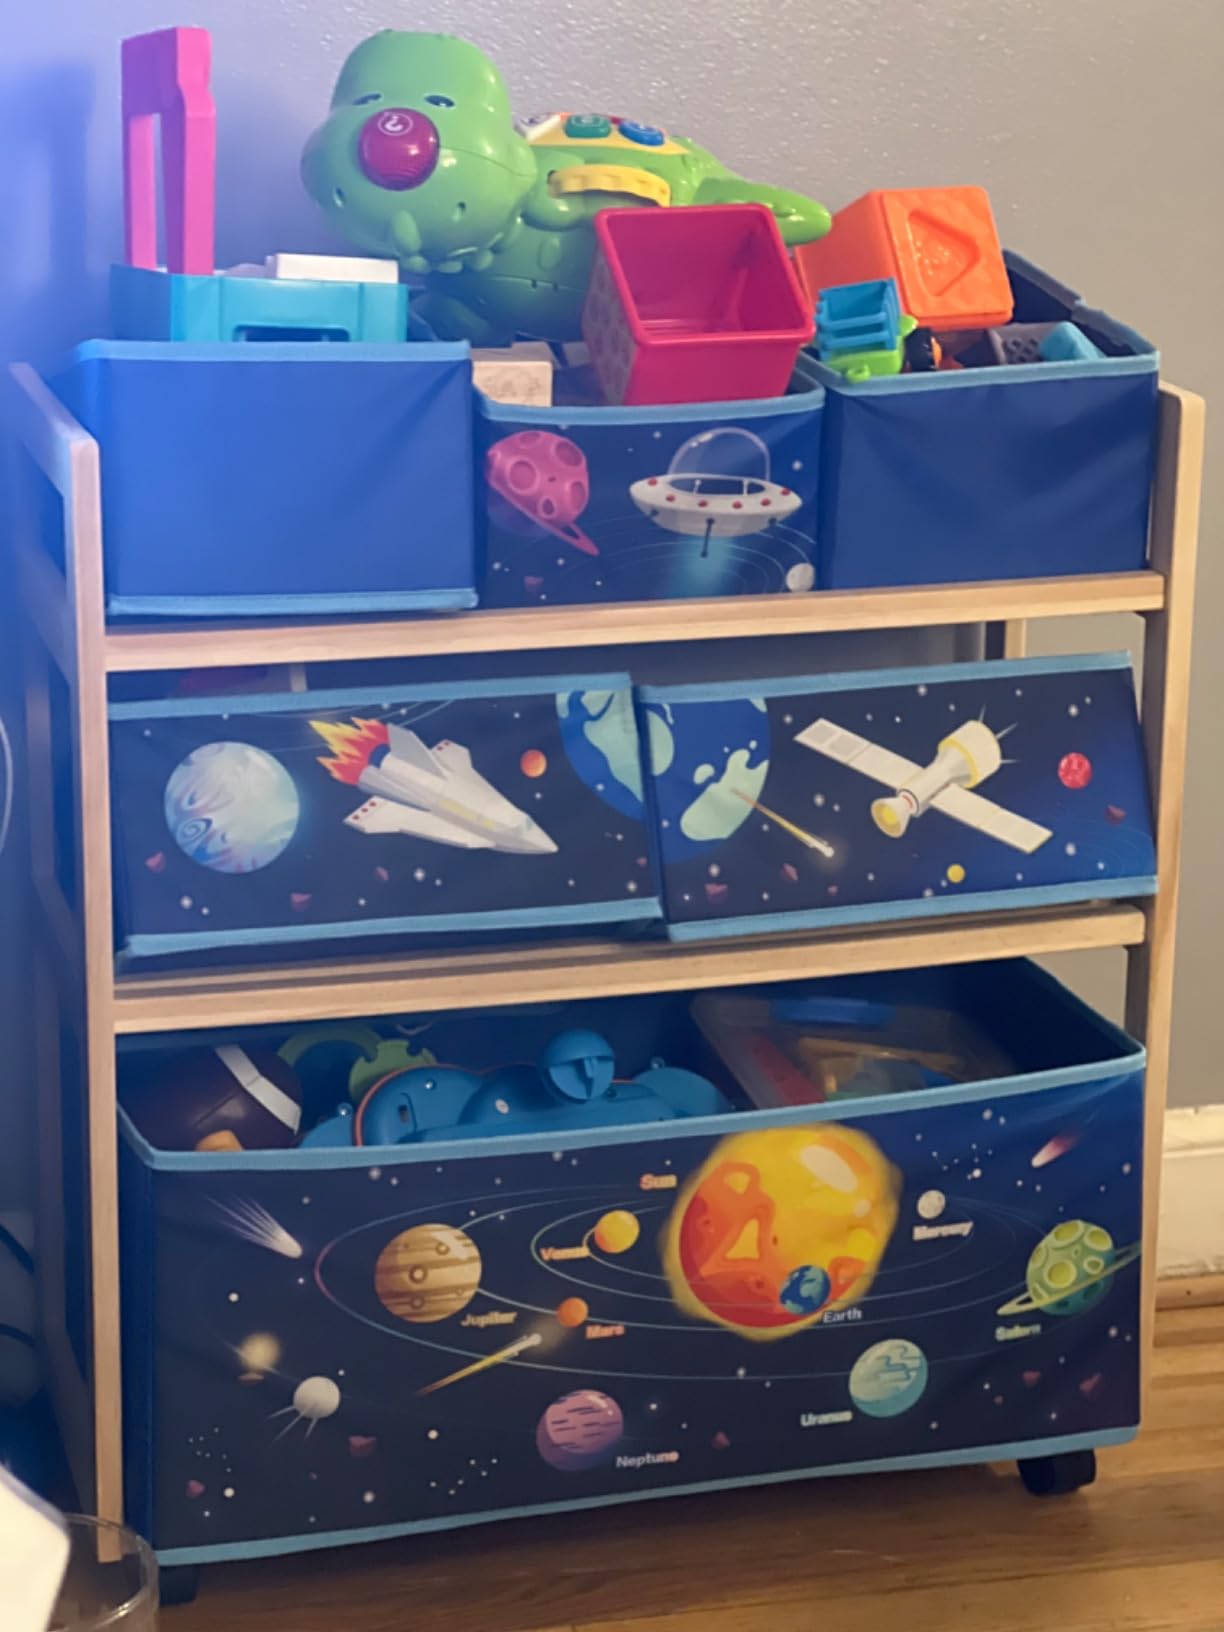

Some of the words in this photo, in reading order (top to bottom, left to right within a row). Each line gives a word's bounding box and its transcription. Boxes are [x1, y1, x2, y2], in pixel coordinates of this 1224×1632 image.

[639, 1173, 677, 1190] Sun
[460, 1311, 517, 1328] Jupiter
[823, 1307, 863, 1323] Earth
[585, 1325, 625, 1339] Mars
[615, 1452, 679, 1469] Neptune
